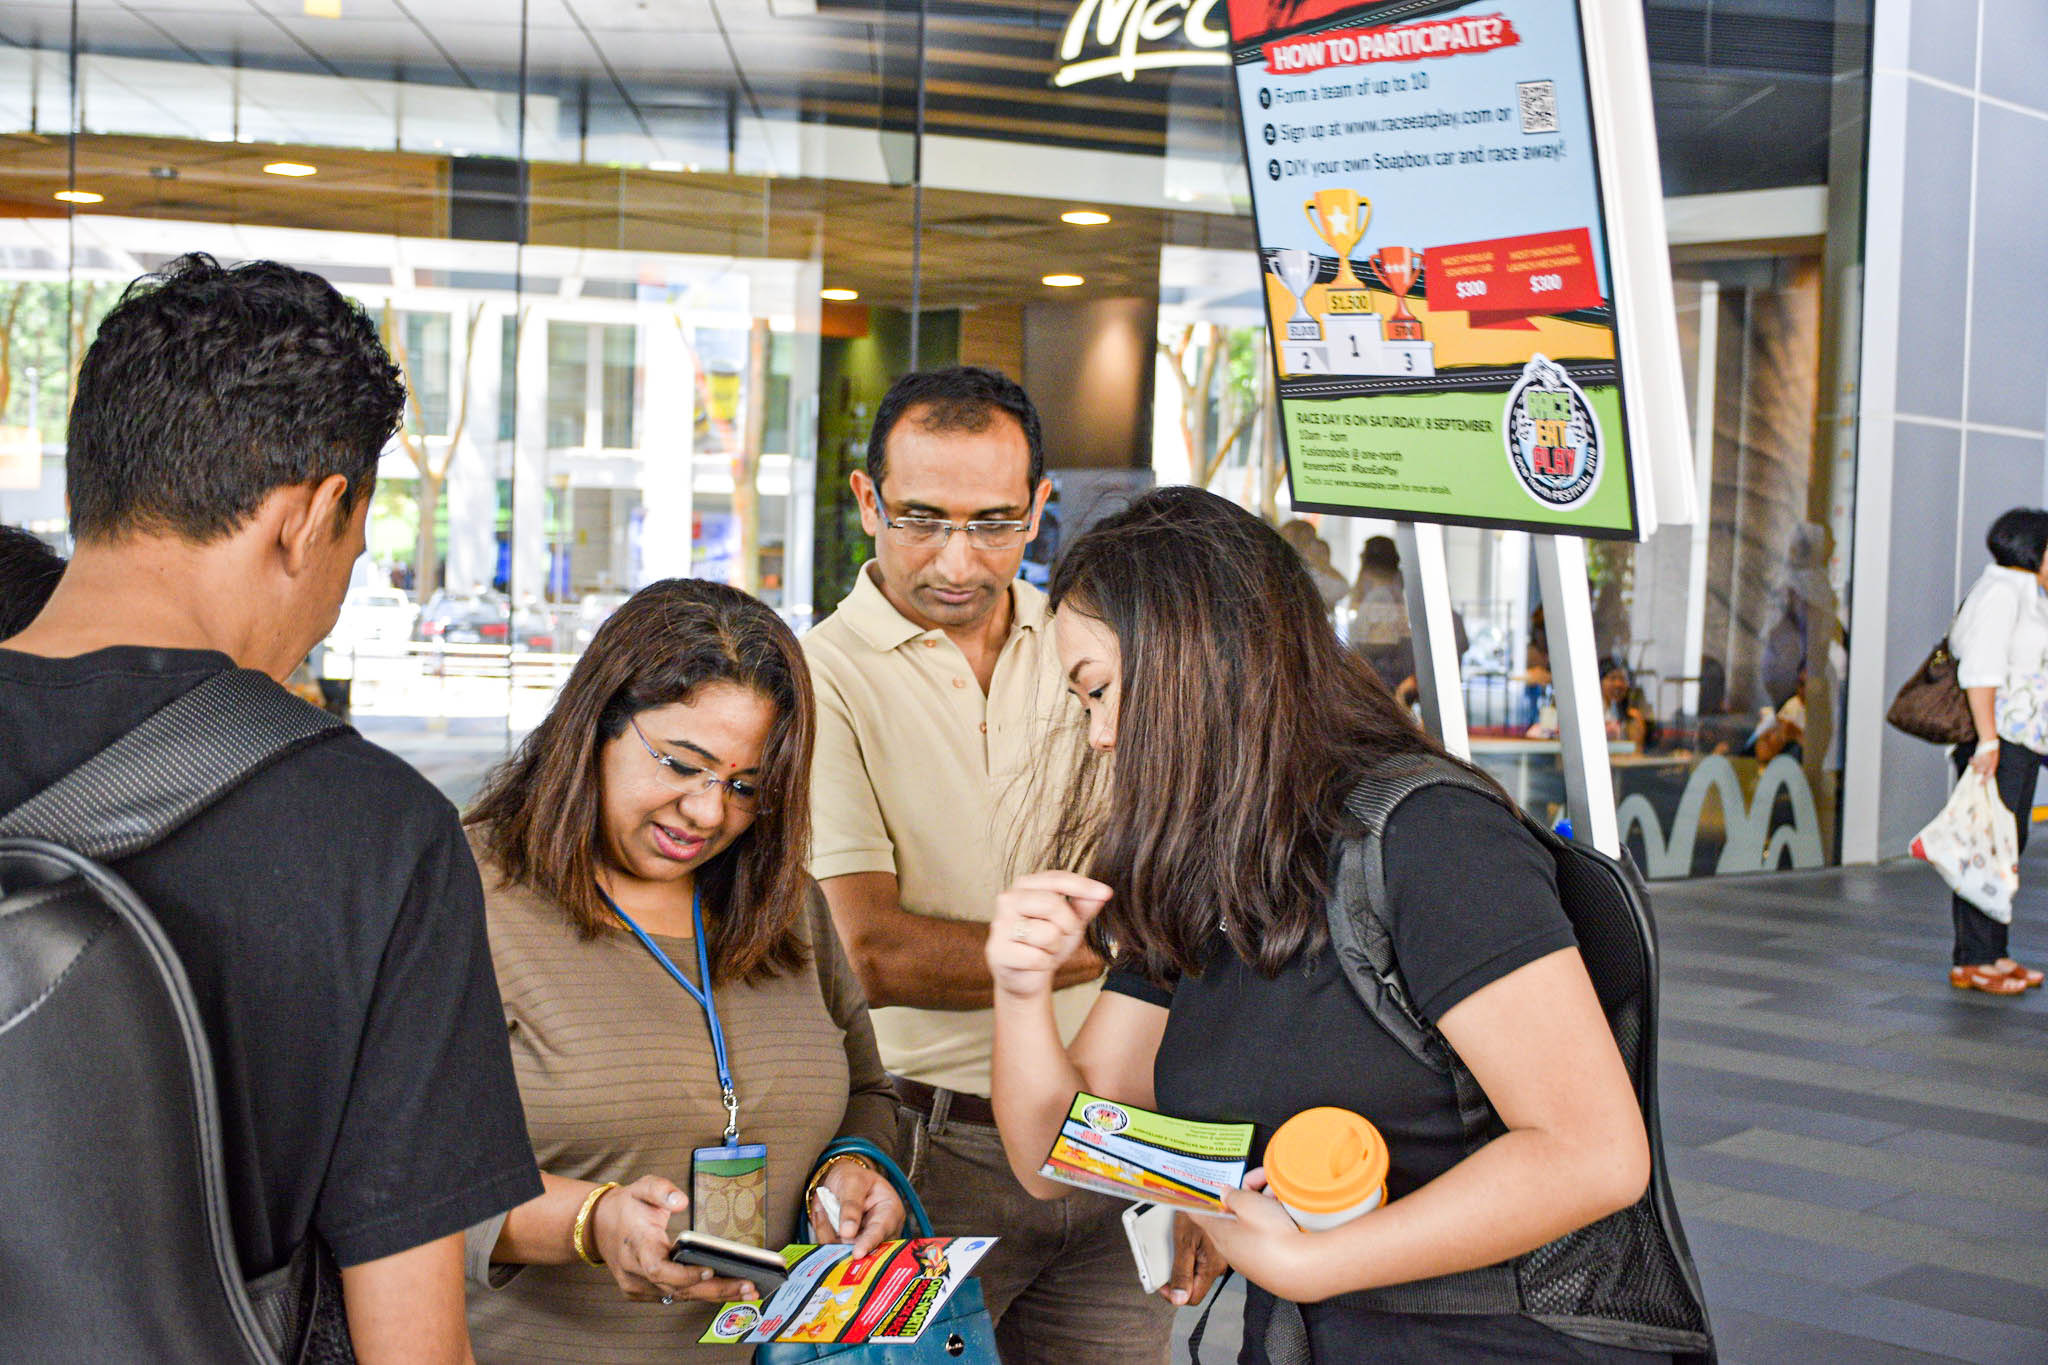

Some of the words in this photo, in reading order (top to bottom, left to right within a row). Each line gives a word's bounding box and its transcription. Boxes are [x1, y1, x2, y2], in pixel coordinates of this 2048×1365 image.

[1273, 41, 1324, 71] HOW
[1324, 37, 1351, 66] TO
[1357, 18, 1503, 60] PARTICIPATE?
[1275, 85, 1306, 104] Form
[1311, 89, 1317, 101] a
[1320, 82, 1350, 99] team
[1357, 77, 1371, 96] of
[1373, 79, 1388, 99] up
[1393, 76, 1408, 92] to
[1411, 71, 1430, 89] 10
[1280, 122, 1305, 144] Sign
[1309, 125, 1324, 142] up
[1328, 120, 1342, 136] at
[1345, 107, 1491, 134] www.raceeatplay.com
[1495, 106, 1512, 122] or
[1285, 158, 1309, 177] DIY
[1312, 158, 1340, 177] your
[1343, 157, 1370, 172] own
[1374, 152, 1430, 172] Soapbox
[1435, 150, 1460, 164] car
[1463, 145, 1484, 164] and
[1490, 147, 1518, 162] race
[1523, 139, 1566, 163] away!
[1456, 280, 1487, 299] $300
[1530, 274, 1562, 293] $300
[1331, 295, 1368, 310] $1,500
[1350, 335, 1360, 357] 1
[1302, 352, 1310, 369] 2
[1404, 353, 1413, 371] 3
[1296, 412, 1320, 425] RACE
[1322, 413, 1340, 425] DAY
[1353, 415, 1368, 426] ON
[1370, 415, 1422, 430] SATURDAY,
[1434, 418, 1494, 433] SEPTEMBER
[1535, 419, 1567, 448] EAT
[1533, 446, 1576, 476] PLAY
[1552, 475, 1592, 502] FESTIVAL
